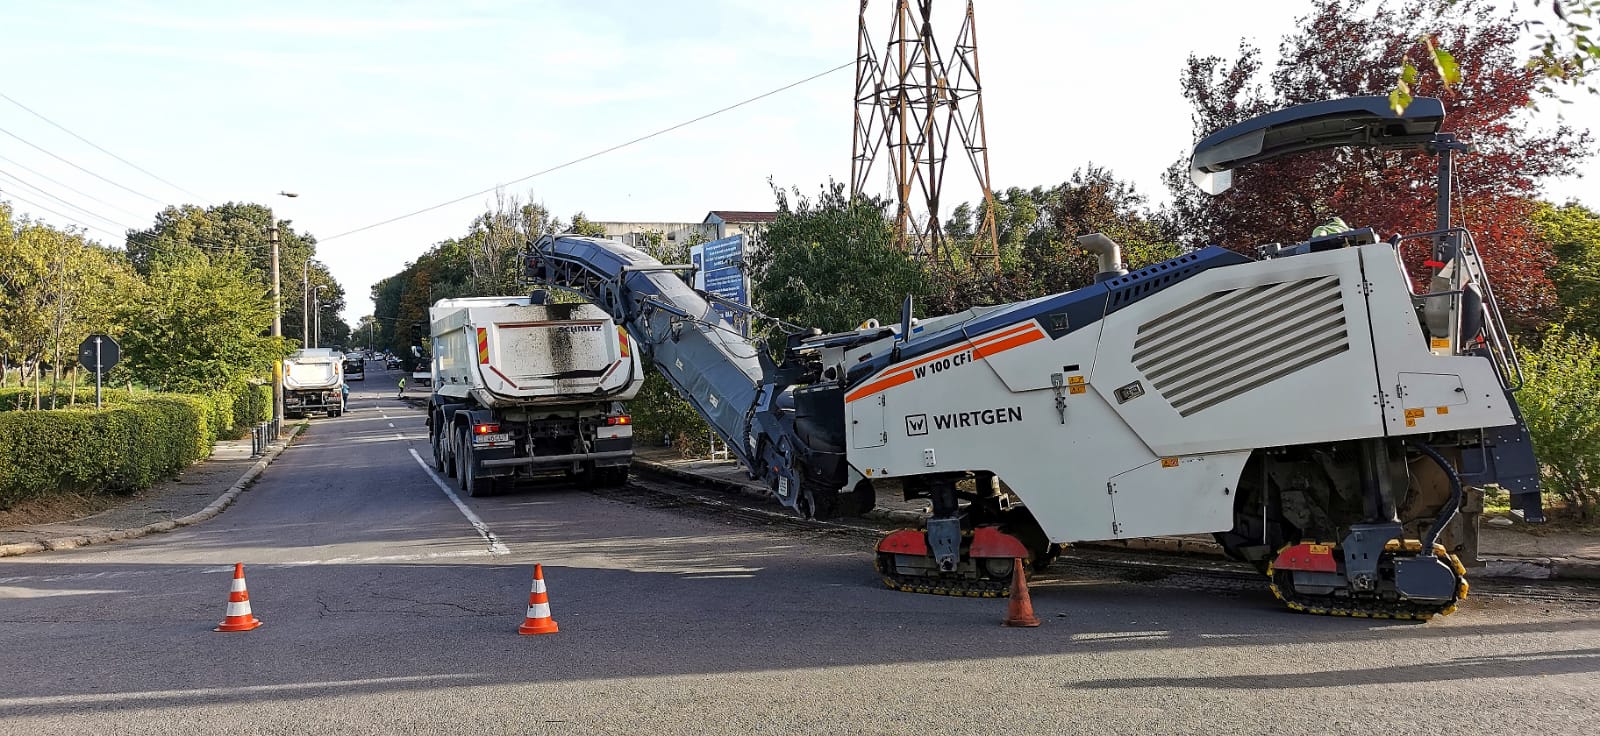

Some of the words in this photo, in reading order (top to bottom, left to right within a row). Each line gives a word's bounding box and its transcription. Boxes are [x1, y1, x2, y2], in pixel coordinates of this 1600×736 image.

[559, 325, 602, 333] SCHMITZ
[914, 365, 926, 379] W
[929, 358, 951, 374] 100
[933, 406, 1023, 430] WIRTGEN
